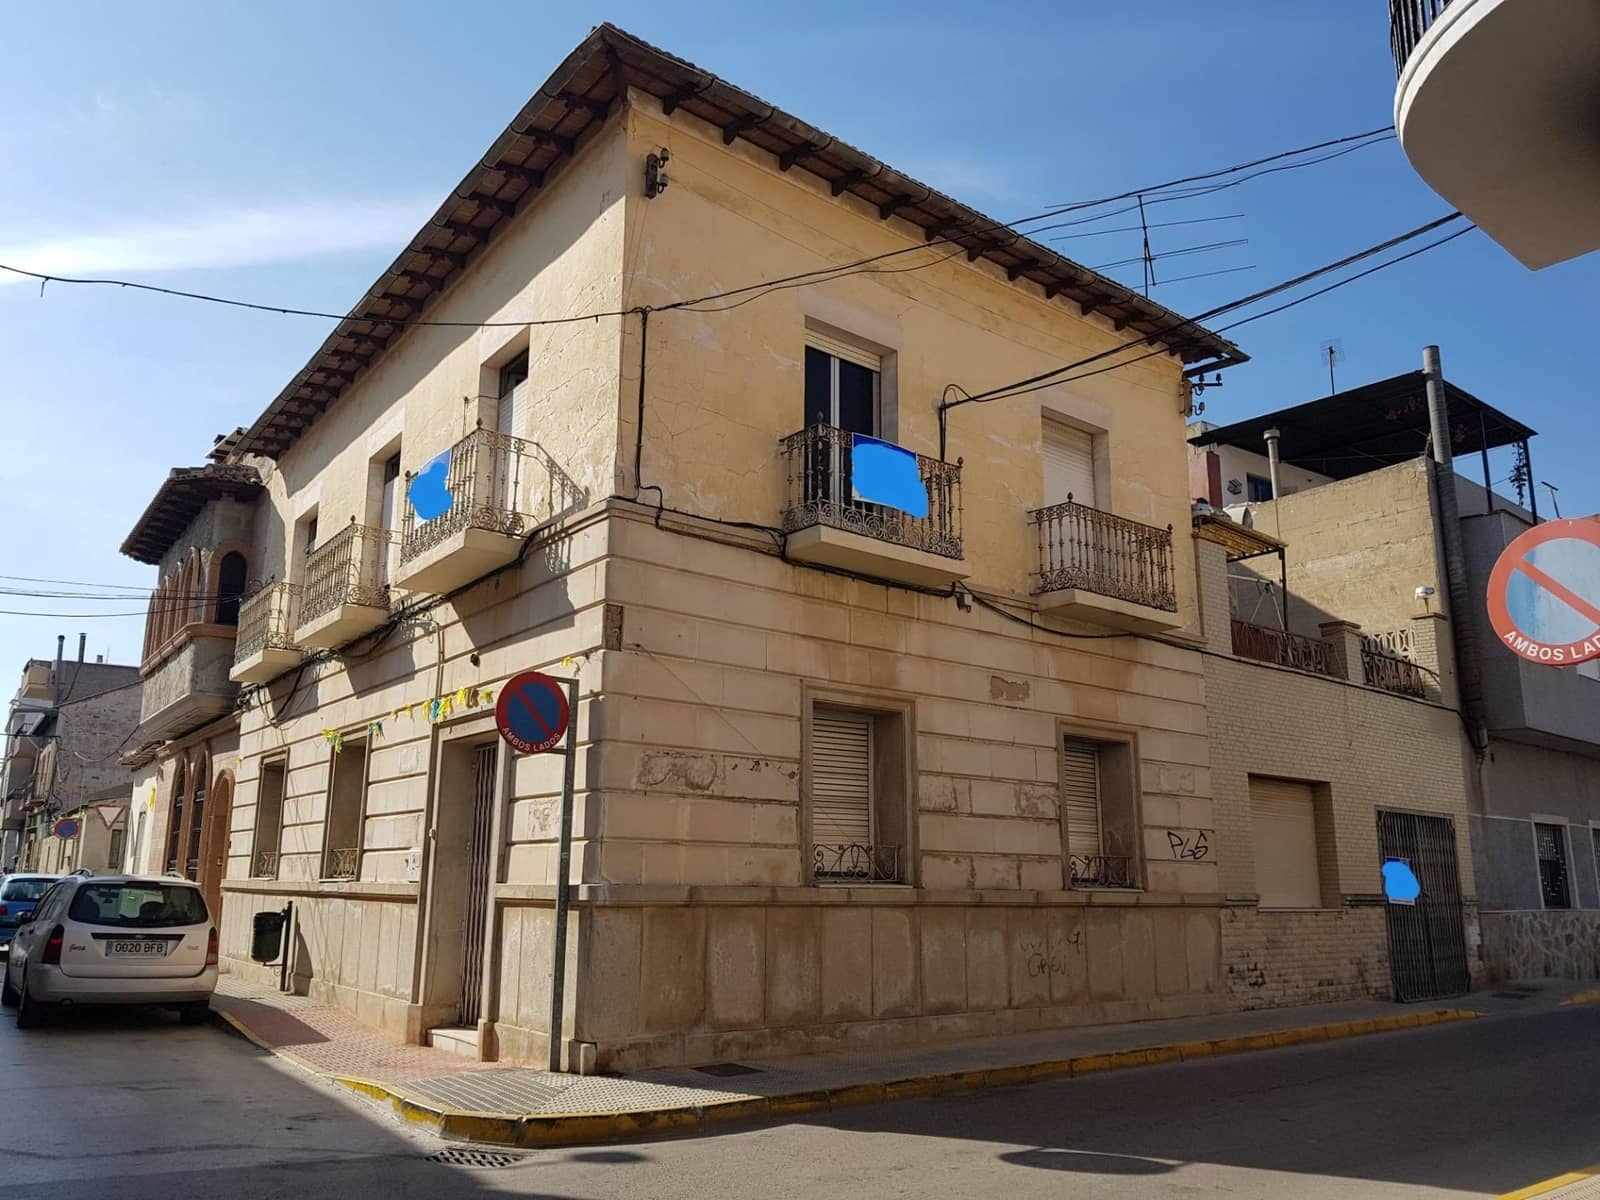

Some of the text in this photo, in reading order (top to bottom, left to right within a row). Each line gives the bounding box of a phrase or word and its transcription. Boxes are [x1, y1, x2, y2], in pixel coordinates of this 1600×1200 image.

[1504, 631, 1564, 661] AMBOS
[502, 727, 560, 751] AMBOS LADOS
[115, 943, 141, 953] 0020
